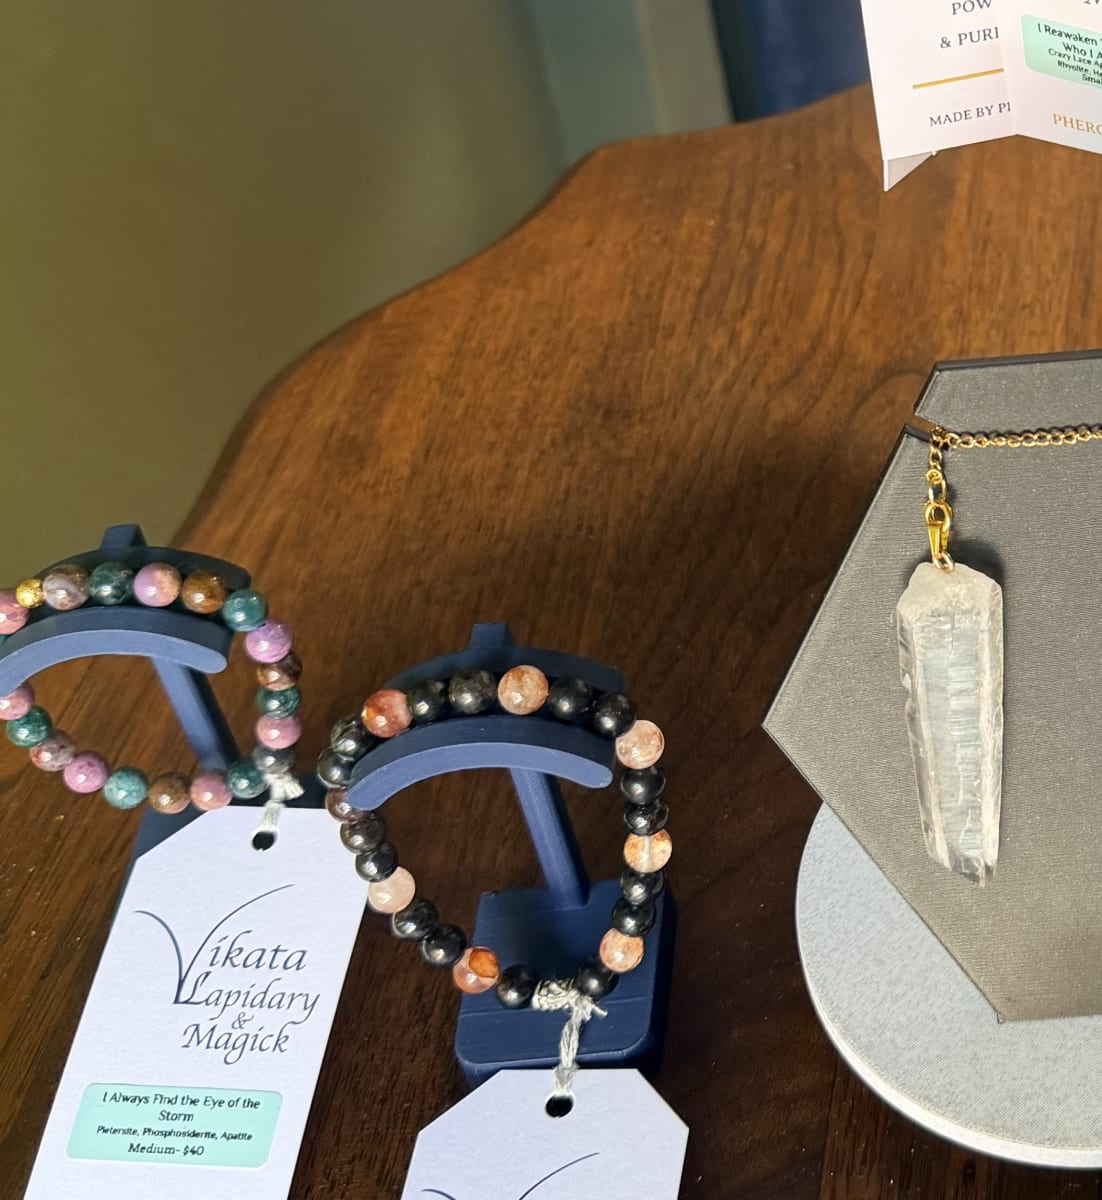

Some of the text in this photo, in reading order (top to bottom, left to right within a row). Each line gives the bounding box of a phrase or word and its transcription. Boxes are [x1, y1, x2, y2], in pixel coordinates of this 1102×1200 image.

[939, 36, 952, 49] &
[1044, 24, 1098, 46] Reawaken
[1048, 48, 1071, 61] Crazy
[1073, 55, 1092, 65] Lace
[1062, 42, 1087, 56] Who
[929, 109, 972, 127] MADE
[976, 105, 994, 118] BY
[134, 883, 308, 1005] Vikata
[183, 971, 320, 1025] Lapidary
[231, 1012, 254, 1030] &
[181, 1022, 290, 1065] Magick
[102, 1091, 261, 1110] I Always Find the Eye of the
[158, 1109, 194, 1122] Storm
[96, 1125, 253, 1142] Pietersite, Phosphosiderite, Apatite
[128, 1143, 204, 1157] Medium- $40
